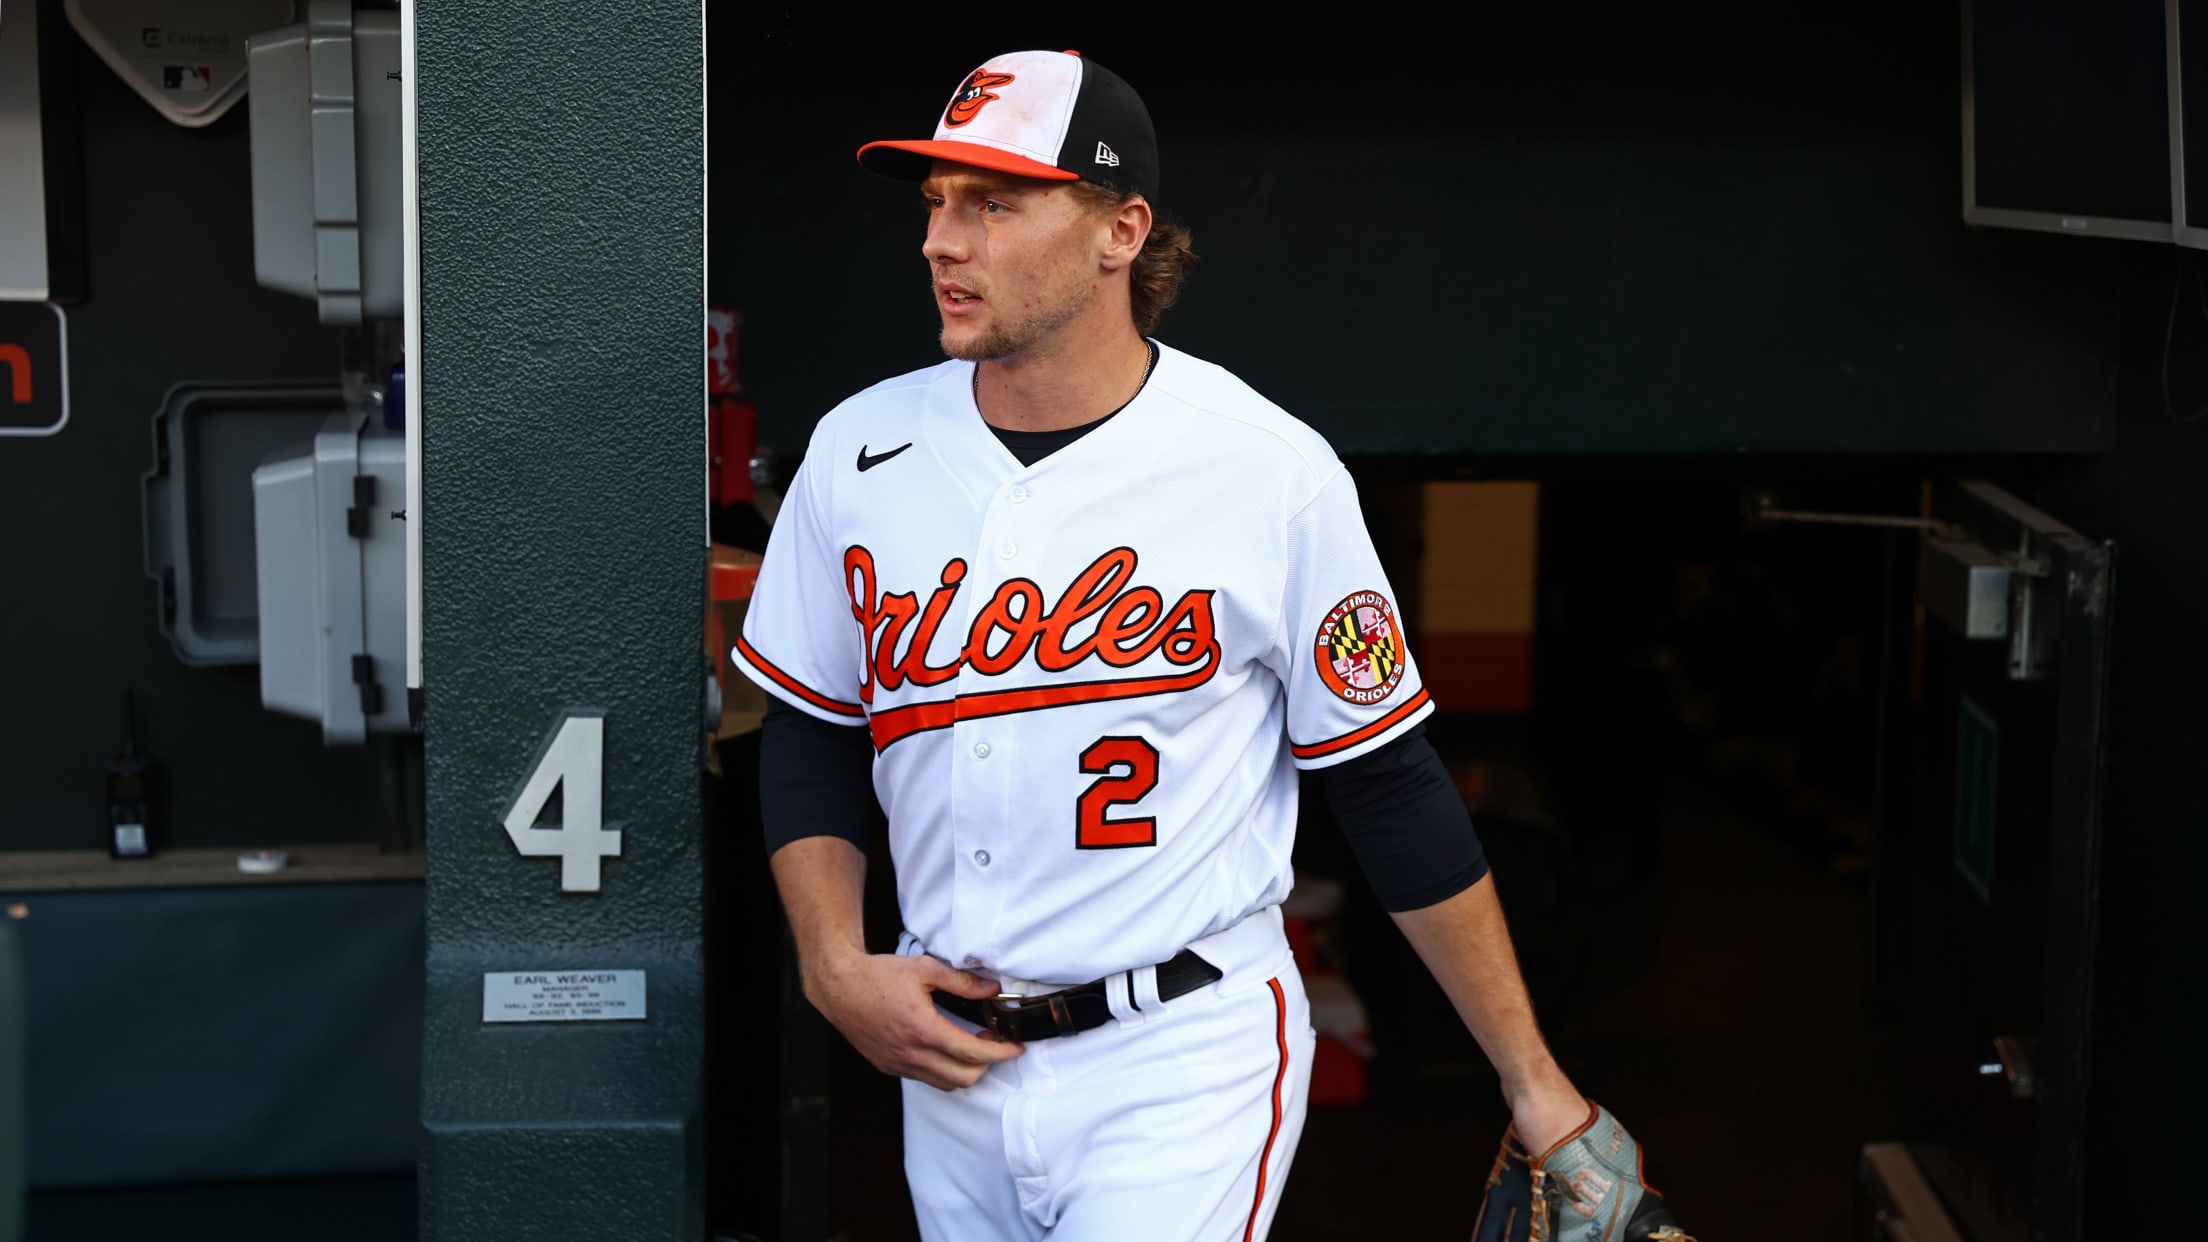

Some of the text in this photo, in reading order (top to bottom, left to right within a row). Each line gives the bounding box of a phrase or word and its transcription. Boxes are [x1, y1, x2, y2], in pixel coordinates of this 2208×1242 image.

[844, 544, 1221, 706] Orioles
[1318, 593, 1392, 647] BALTIMORE
[1343, 663, 1404, 702] ORIOLES
[502, 714, 622, 892] 4
[1076, 735, 1160, 850] 2
[514, 974, 617, 985] EARL WEAVER
